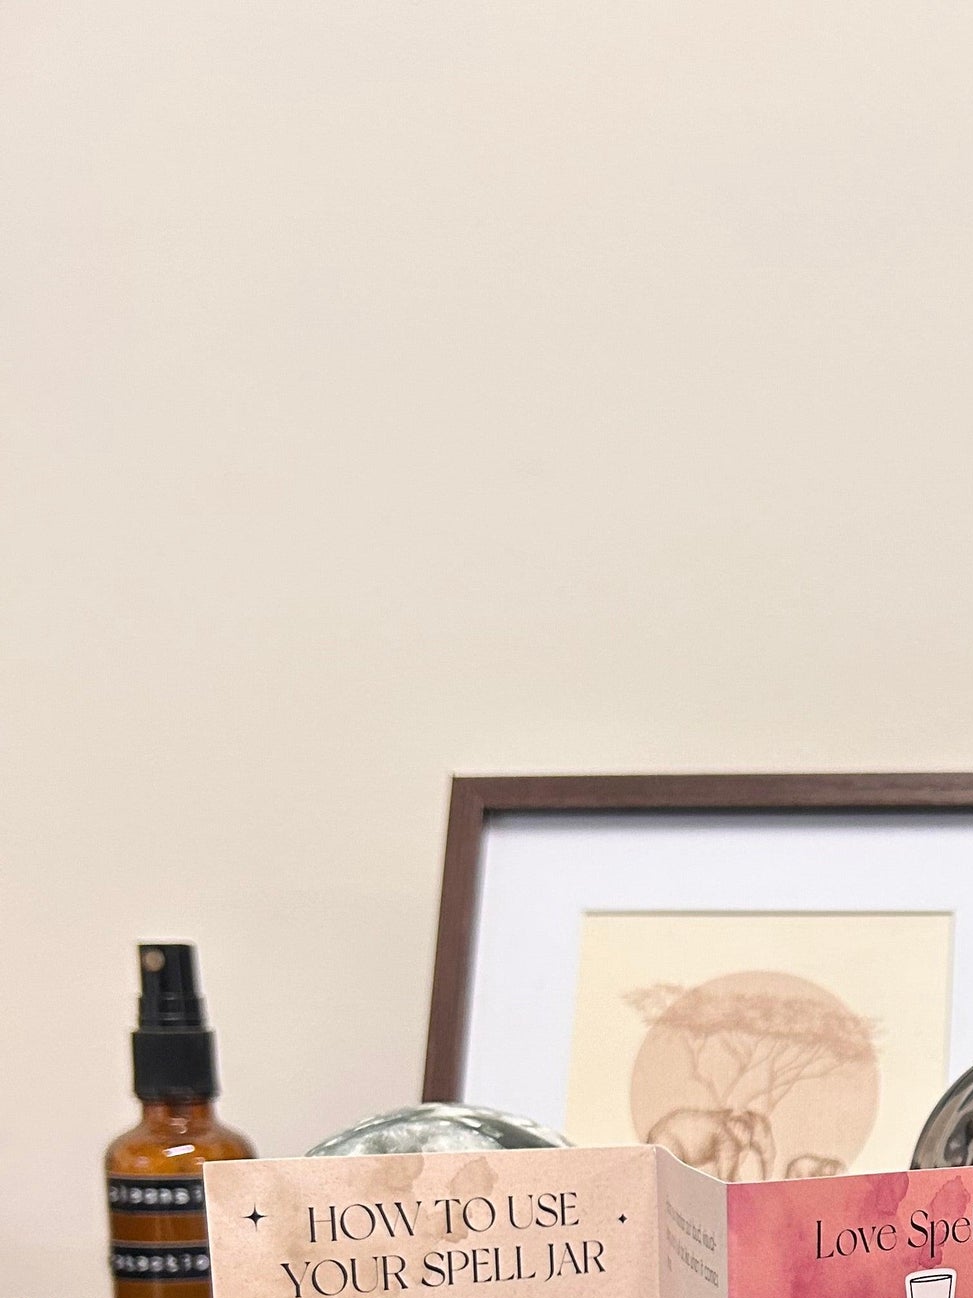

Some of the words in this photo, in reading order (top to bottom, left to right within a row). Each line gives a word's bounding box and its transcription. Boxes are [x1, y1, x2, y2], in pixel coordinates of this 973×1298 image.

[308, 1201, 422, 1243] HOW
[434, 1197, 496, 1235] TO
[508, 1192, 579, 1230] USE
[815, 1218, 897, 1260] Love
[280, 1255, 408, 1298] YOUR
[421, 1246, 536, 1287] SPELL
[546, 1240, 606, 1281] JAR
